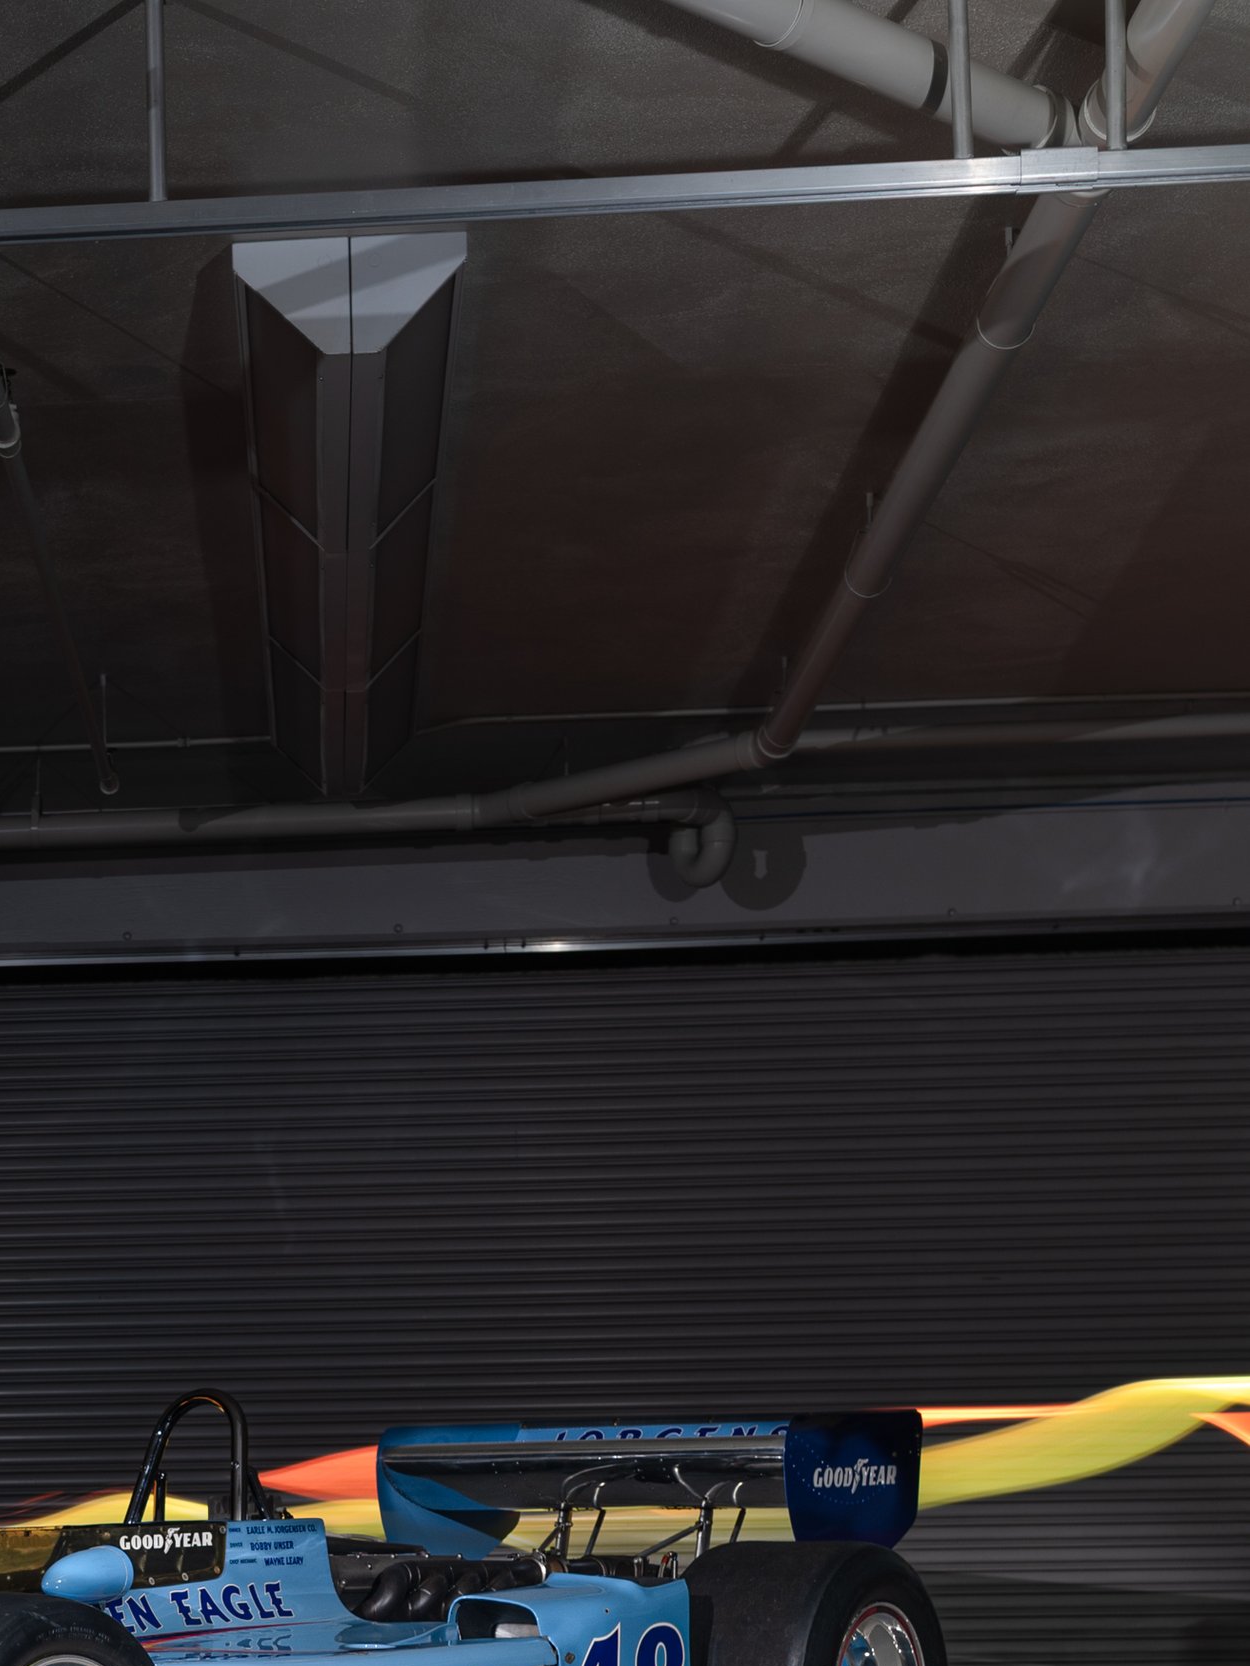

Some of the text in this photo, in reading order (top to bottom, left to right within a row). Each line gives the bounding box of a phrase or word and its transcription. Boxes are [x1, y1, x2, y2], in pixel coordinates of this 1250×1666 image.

[812, 1458, 898, 1494] GOODYEAR
[246, 1526, 265, 1535] EARLE
[274, 1525, 306, 1534] JORGENSEN
[119, 1527, 214, 1554] GOODYEAR
[250, 1542, 272, 1551] BOBBY
[273, 1540, 295, 1550] UNSER
[264, 1557, 285, 1567] WAYNE
[286, 1556, 304, 1566] LEARY
[169, 1580, 294, 1627] EAGLE
